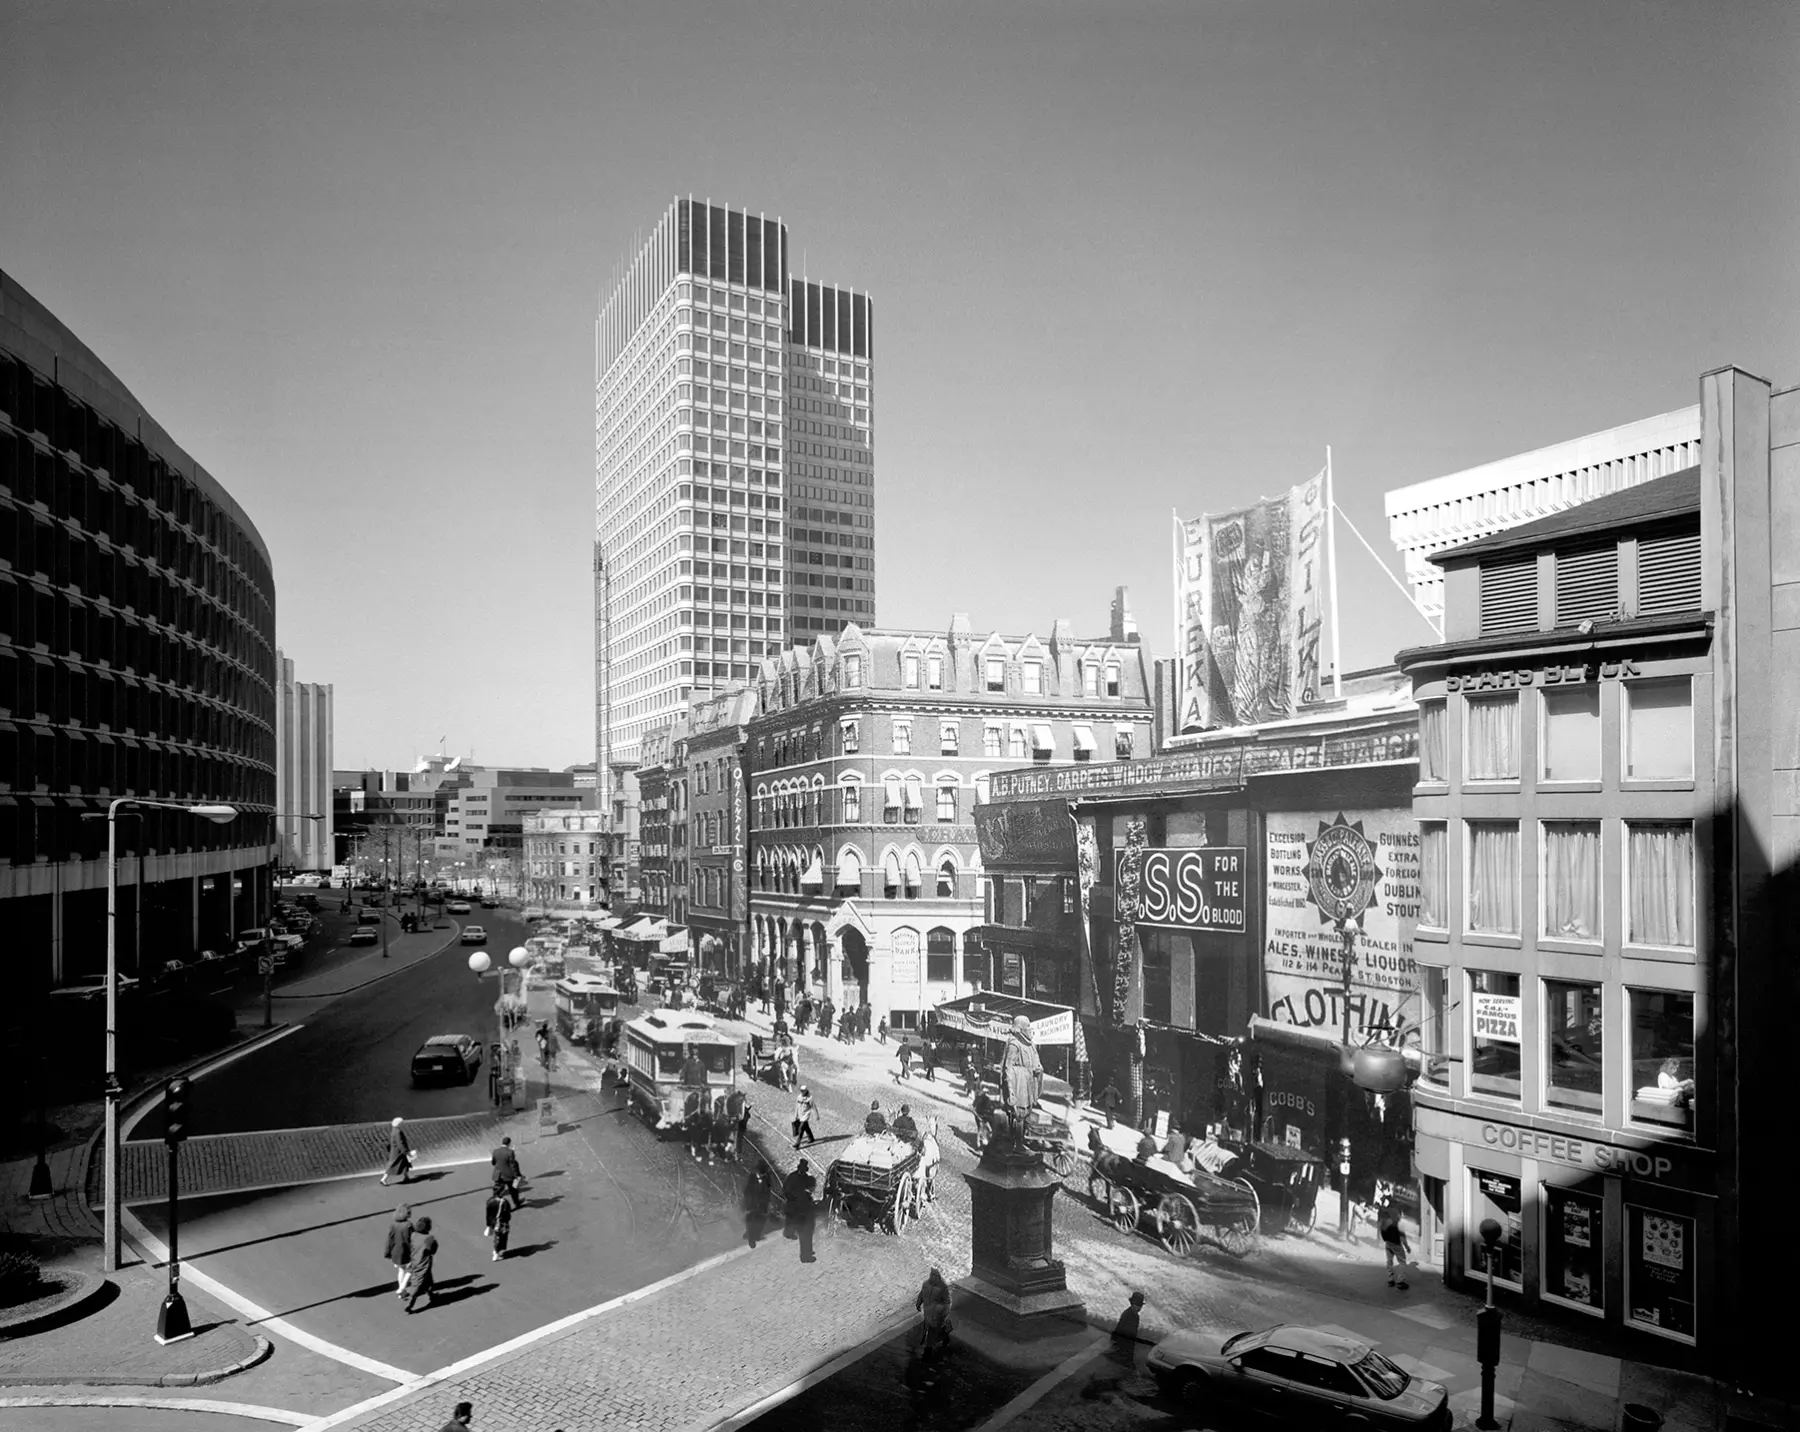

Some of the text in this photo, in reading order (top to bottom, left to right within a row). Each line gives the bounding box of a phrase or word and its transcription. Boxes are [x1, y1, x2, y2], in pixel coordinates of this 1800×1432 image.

[1183, 518, 1205, 722] EUREKA
[1269, 832, 1306, 844] EXCELSIOR
[1270, 848, 1302, 861] BOTTLING
[1388, 852, 1418, 863] EXTRA
[1214, 856, 1238, 872] FOR
[1214, 881, 1239, 897] THE
[1212, 908, 1243, 925] BLOOD
[1274, 928, 1307, 940] IMPORTER
[1360, 937, 1397, 952] DEALER
[1403, 943, 1413, 954] IN
[1282, 958, 1294, 968] 112
[1296, 961, 1303, 970] &
[1036, 1014, 1068, 1030] LAUNDRY
[1476, 1009, 1517, 1020] FAMOUS
[1477, 1016, 1517, 1038] PIZZA
[1269, 1091, 1315, 1117] COBB'S
[1481, 1122, 1673, 1179] COFFEE SHOP
